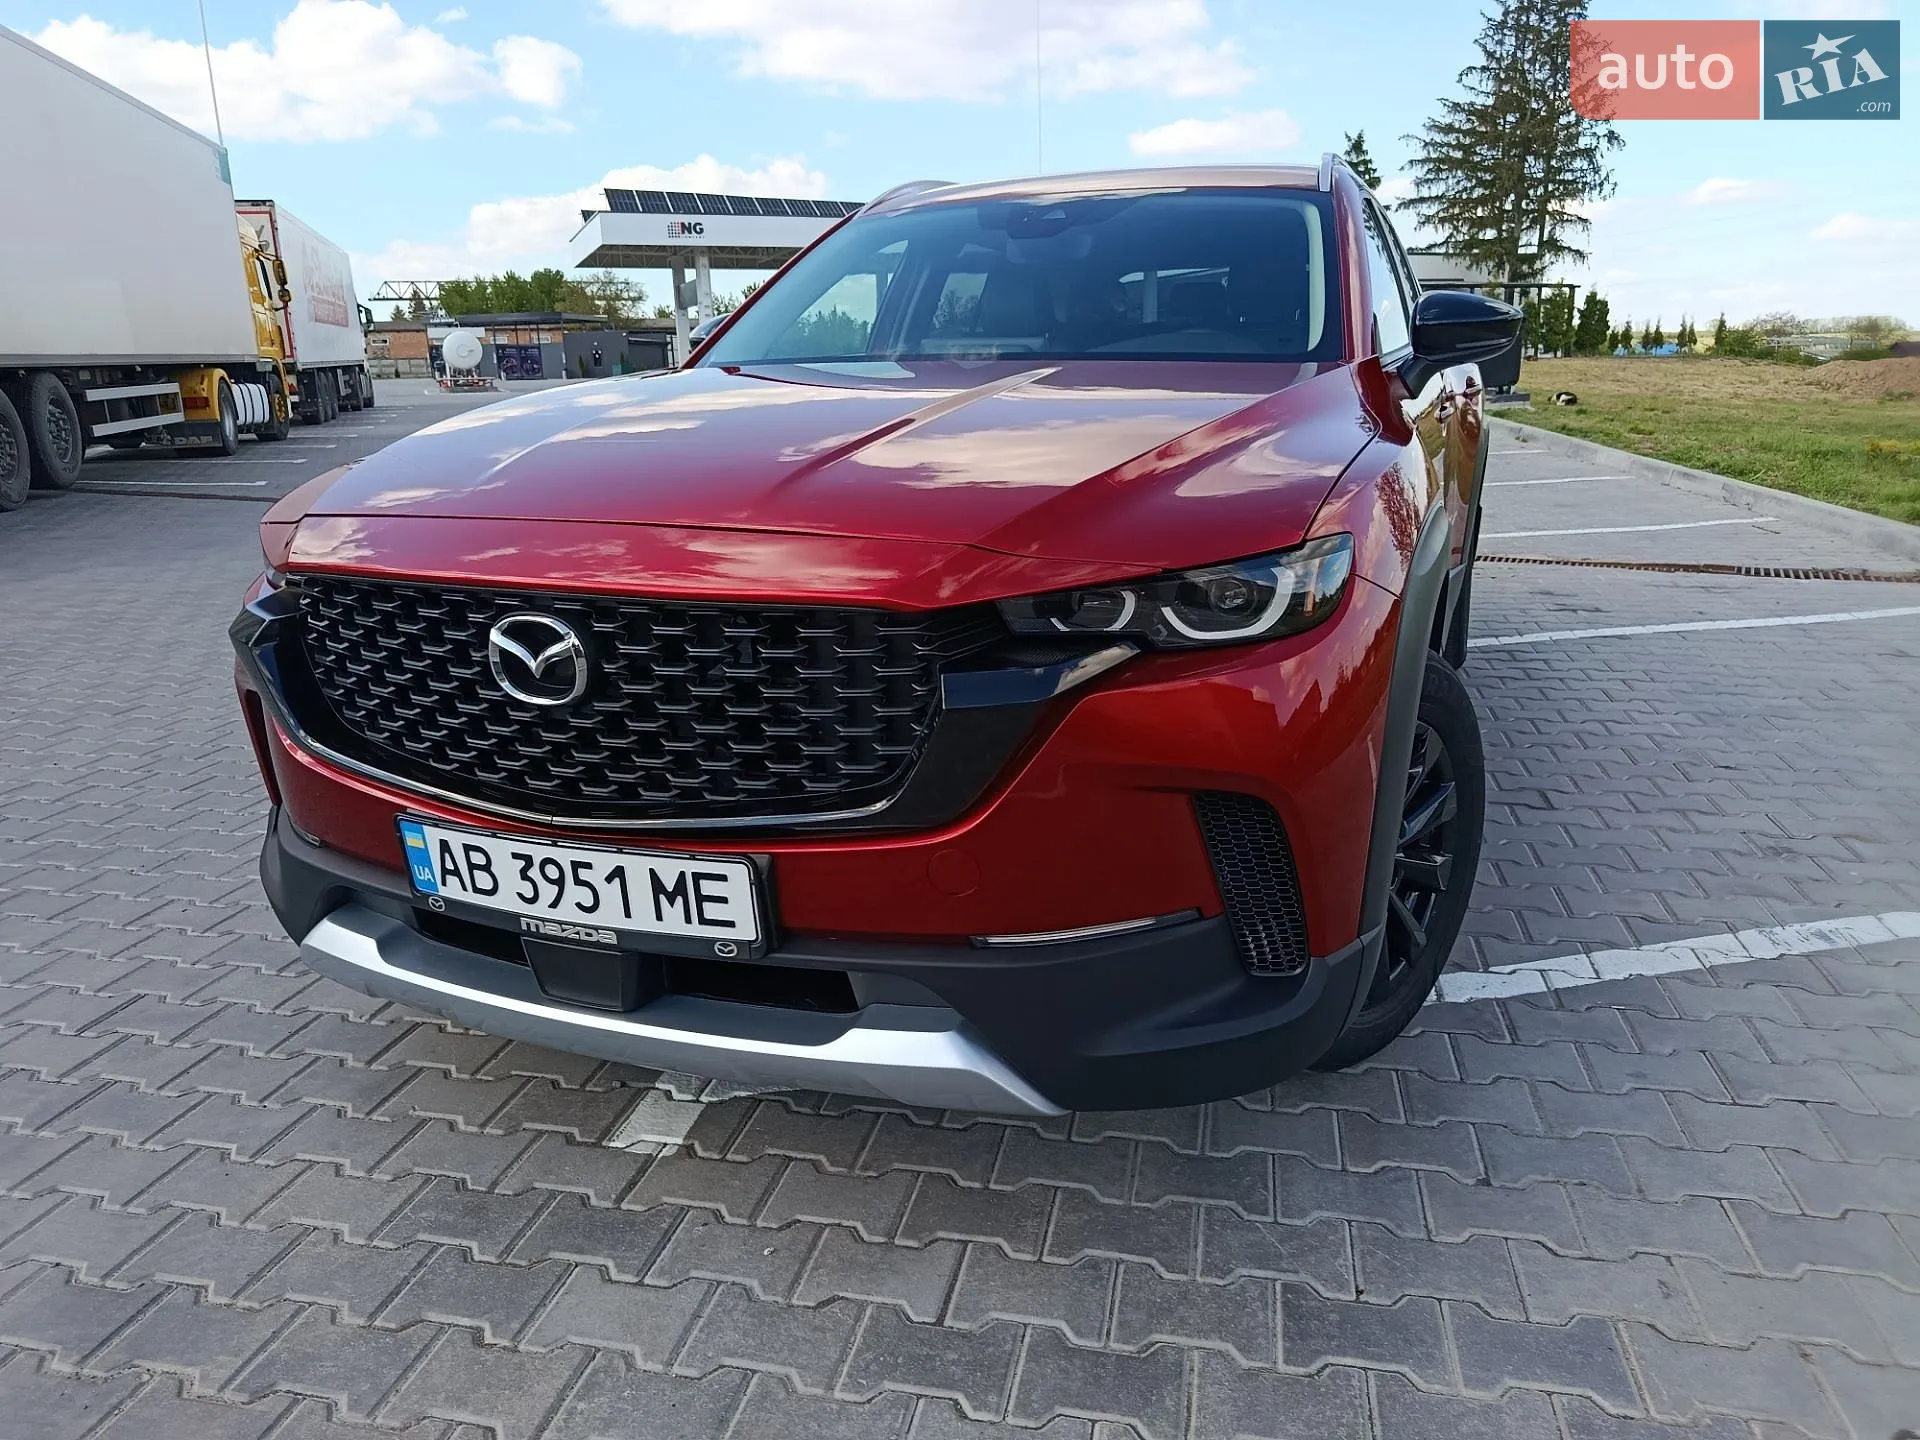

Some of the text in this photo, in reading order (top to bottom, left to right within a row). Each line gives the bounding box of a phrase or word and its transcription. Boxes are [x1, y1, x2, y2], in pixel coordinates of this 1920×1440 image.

[681, 222, 704, 235] NG
[415, 863, 436, 884] UA
[438, 838, 737, 929] AB 3951 ME
